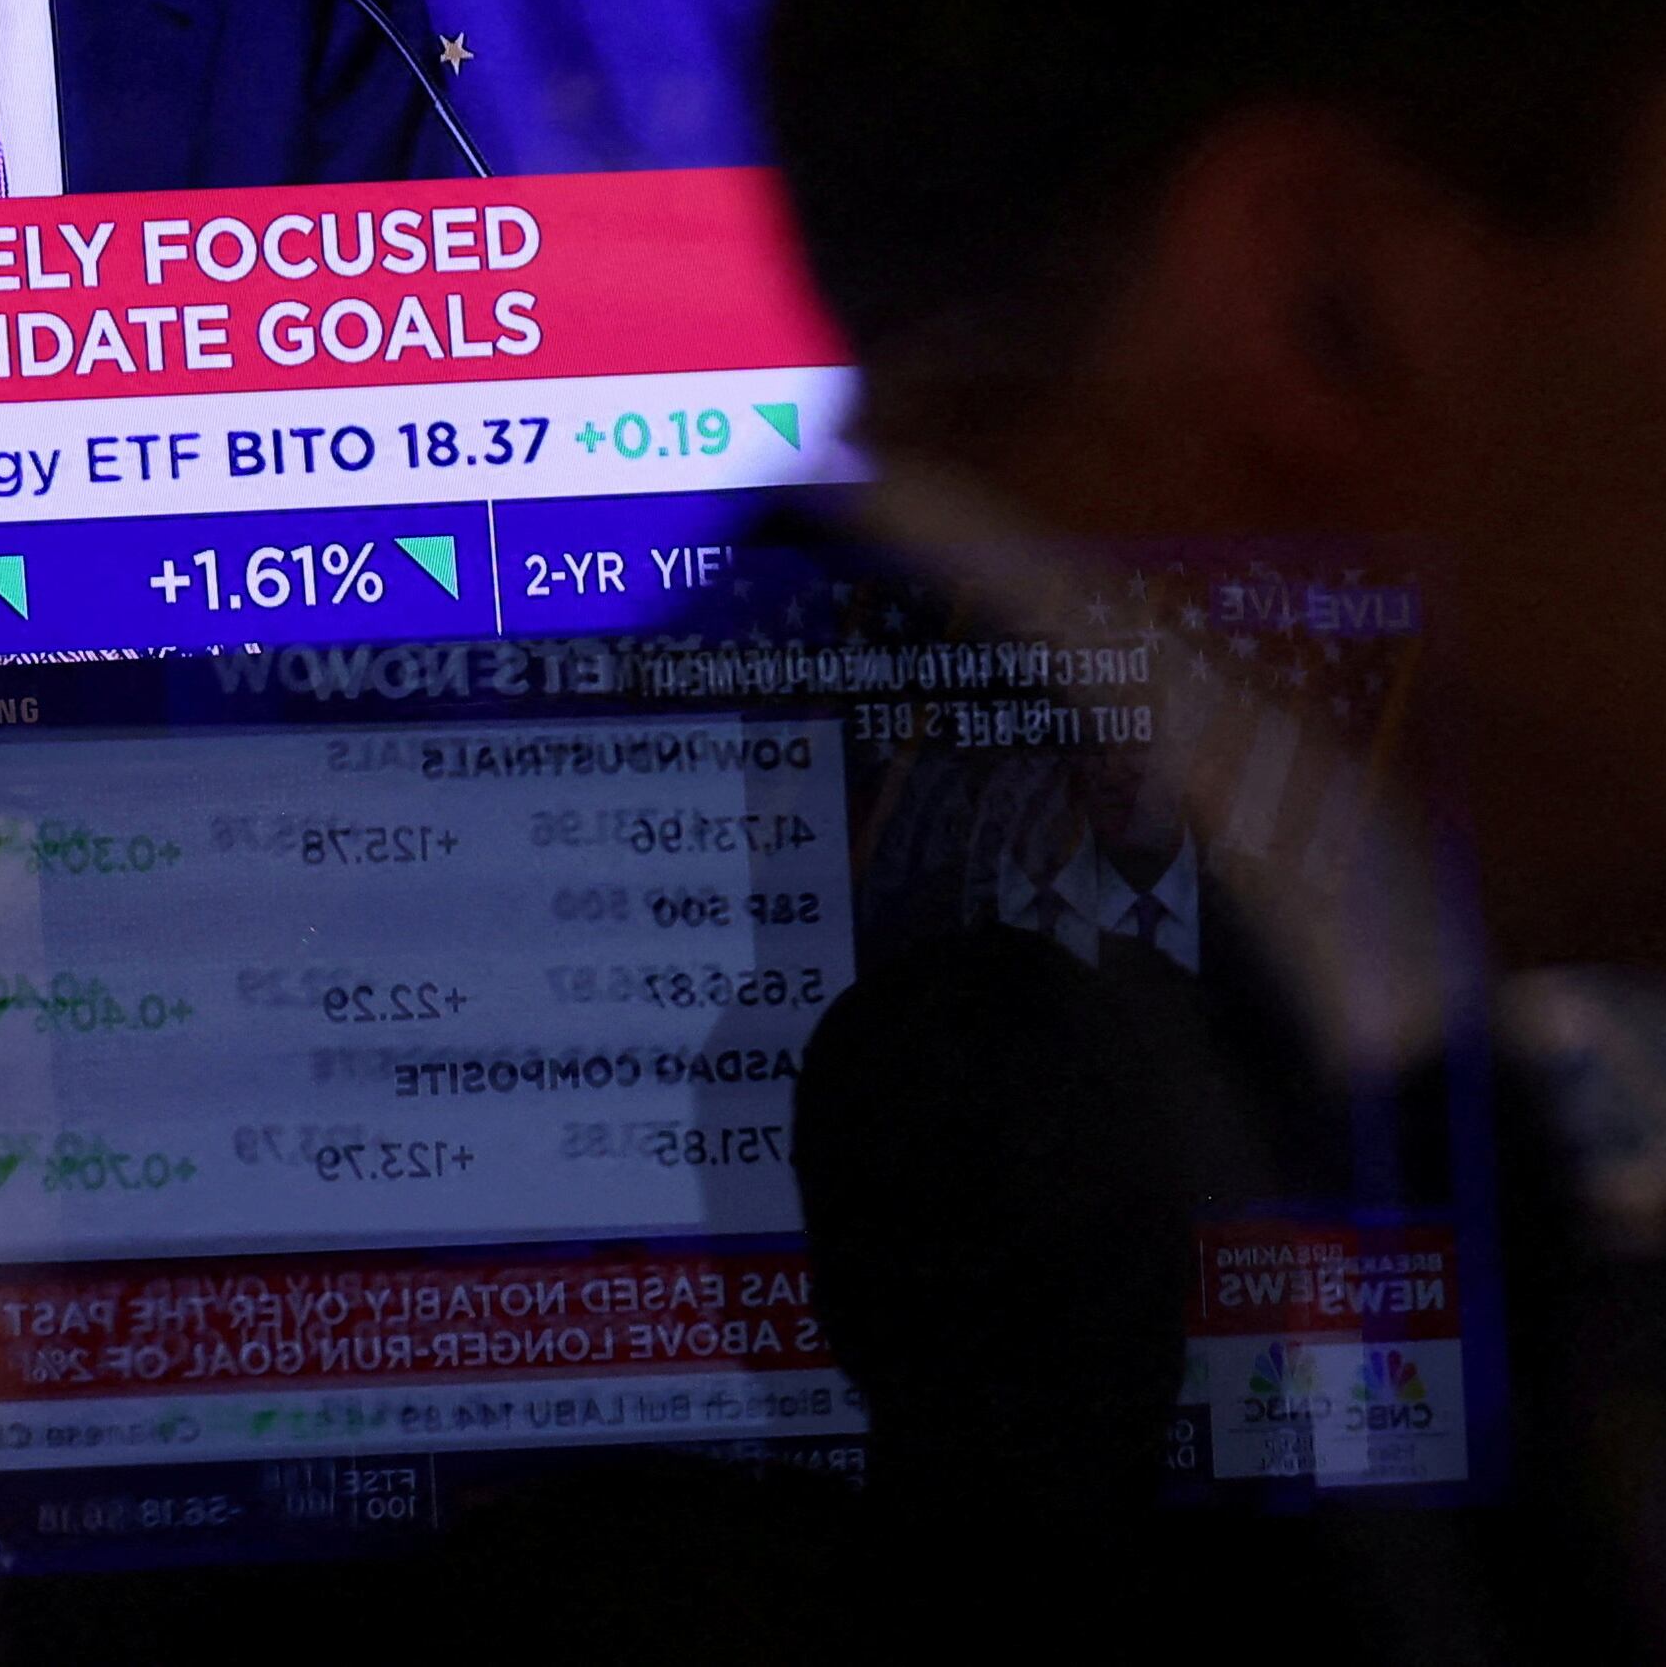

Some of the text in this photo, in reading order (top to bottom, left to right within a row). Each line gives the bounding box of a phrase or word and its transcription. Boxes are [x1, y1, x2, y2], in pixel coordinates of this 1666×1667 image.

[140, 204, 542, 284] FOCUSED
[258, 290, 543, 367] GOALS
[86, 429, 202, 485] ETF
[226, 423, 377, 478] BITO
[396, 416, 552, 472] 18.37
[573, 408, 734, 463] +0.19
[148, 543, 386, 614] +1.61%
[524, 551, 626, 598] 2-YR
